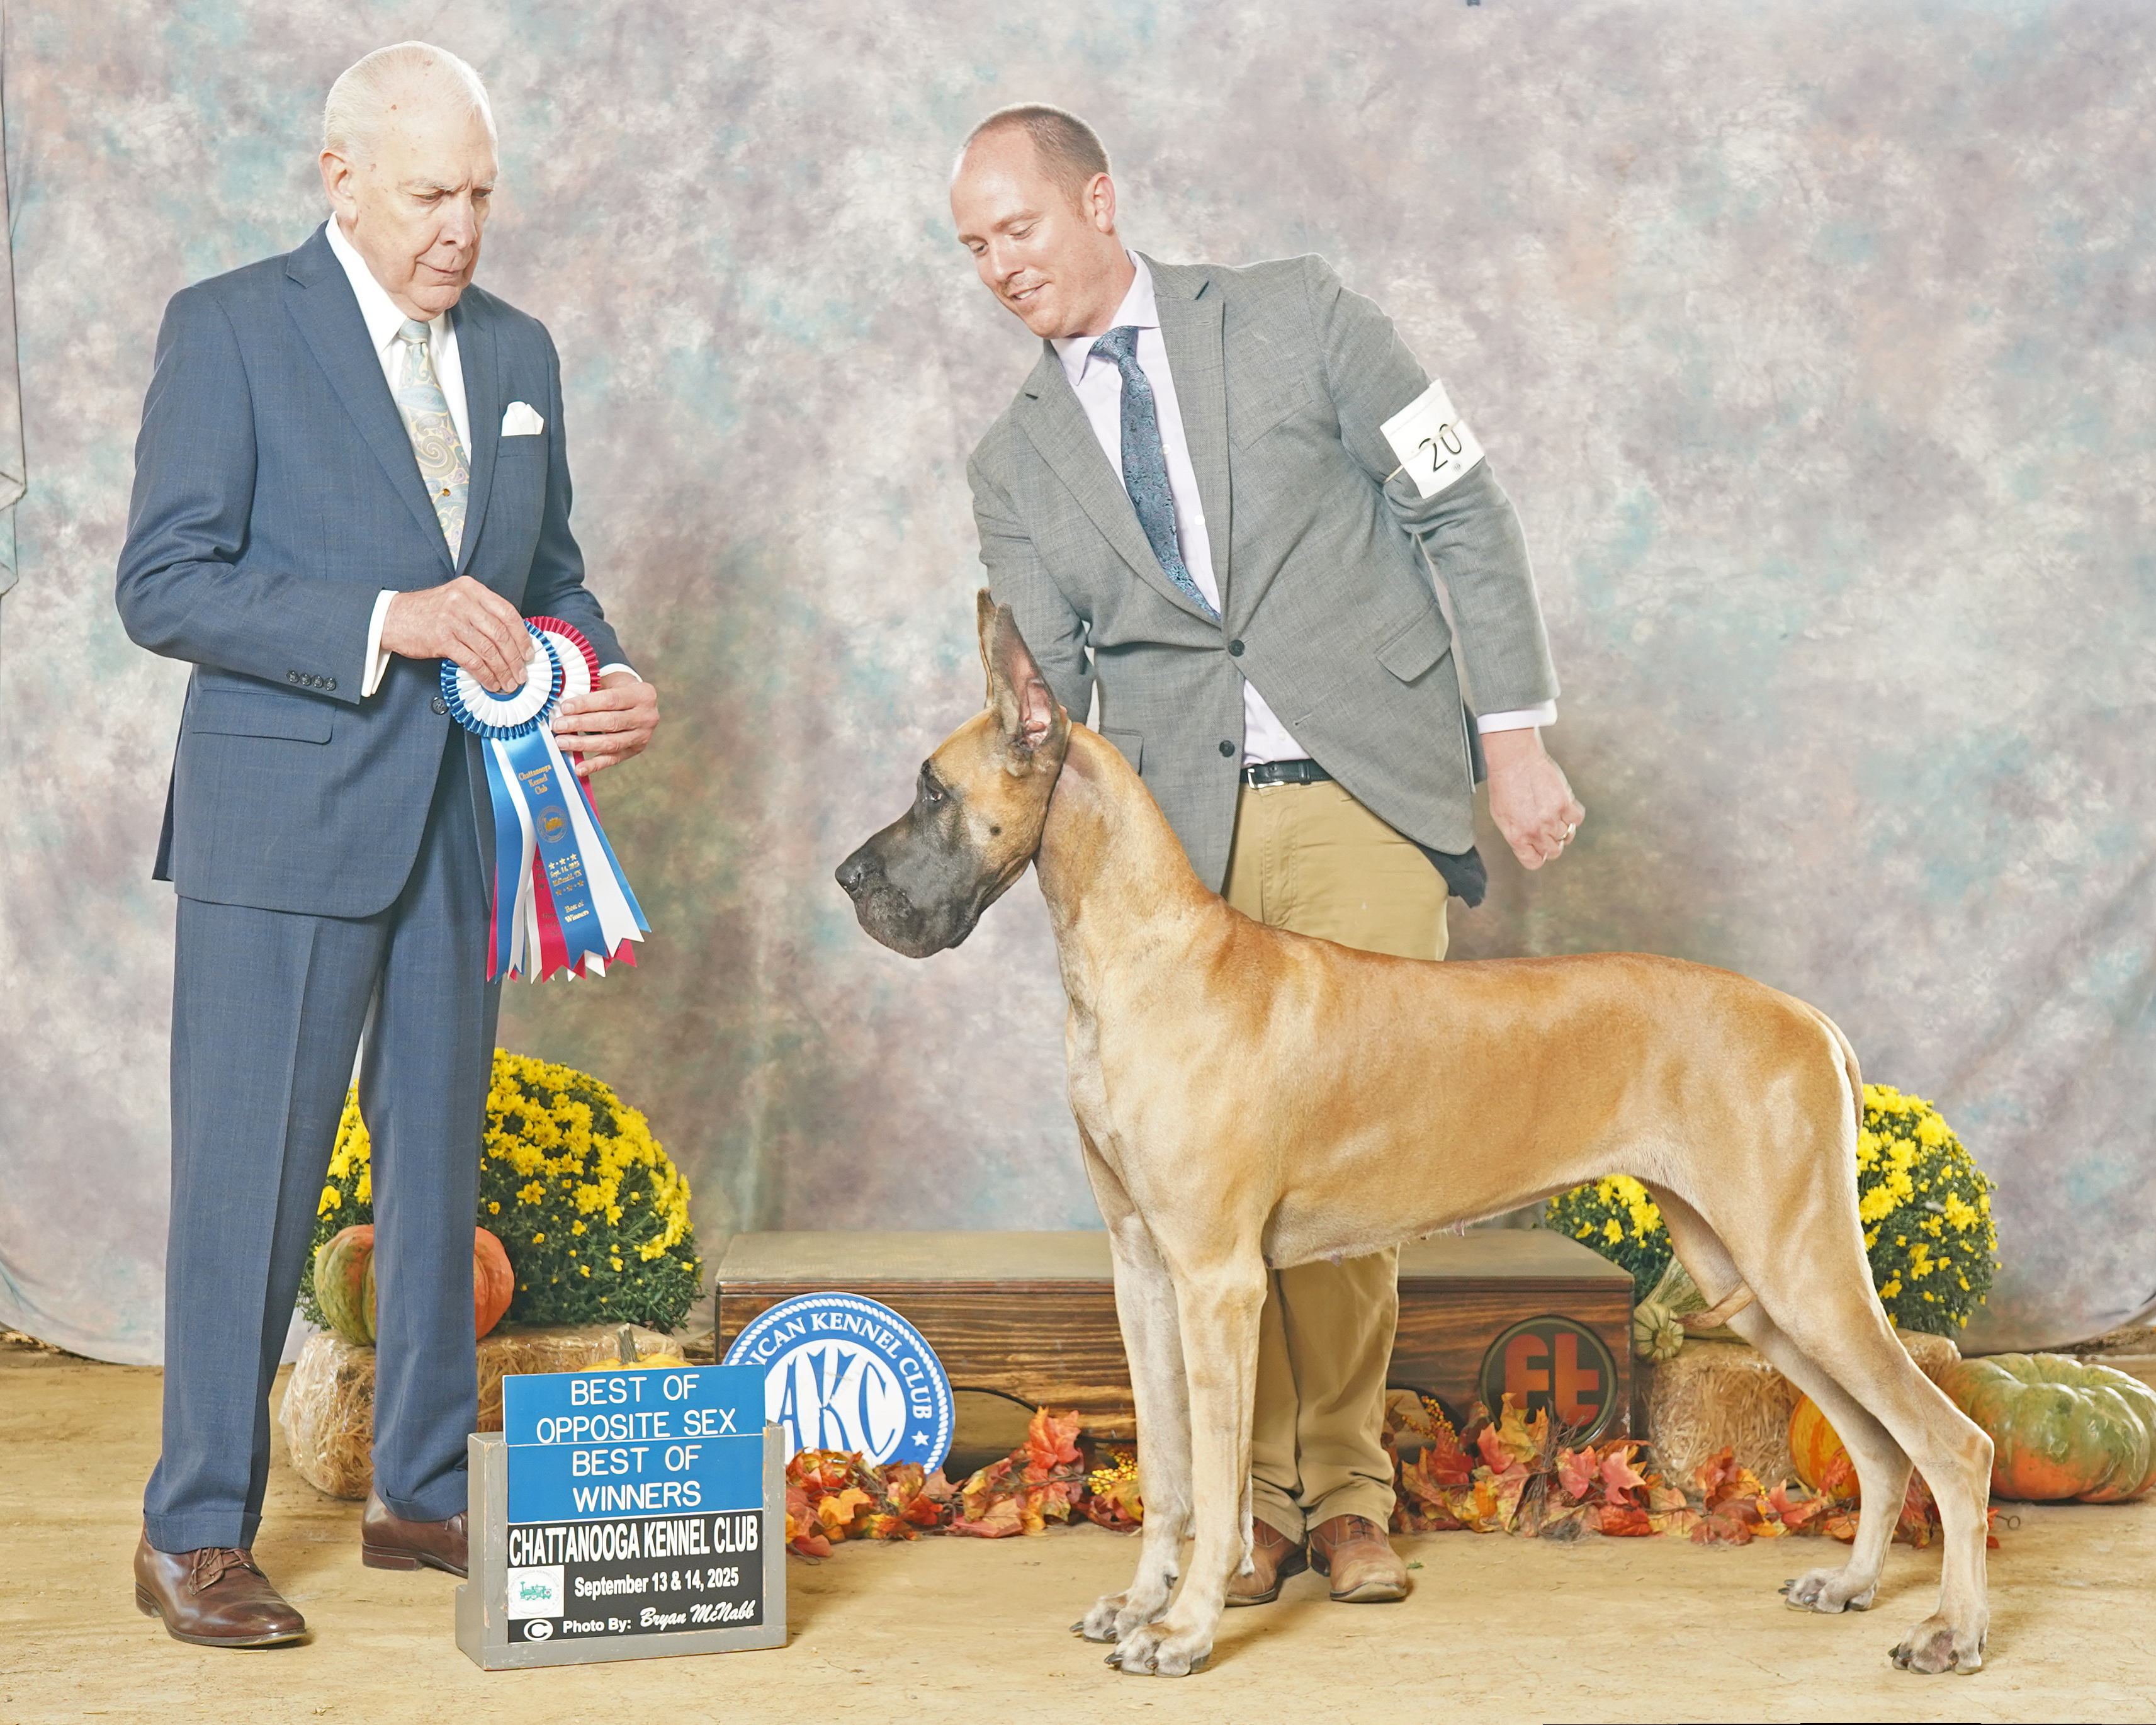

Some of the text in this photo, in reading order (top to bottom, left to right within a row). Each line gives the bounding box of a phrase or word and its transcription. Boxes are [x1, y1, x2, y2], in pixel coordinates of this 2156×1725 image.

[1418, 423, 1462, 473] 20
[518, 764, 552, 781] Chattanooga
[528, 773, 548, 787] Kennel
[534, 784, 548, 795] Club
[565, 910, 589, 923] Winners
[750, 1312, 932, 1420] ICAN KENNEL CLUB
[572, 1374, 700, 1406] BEST OF
[776, 1345, 895, 1457] AKC
[537, 1408, 737, 1444] OPPOSITE SEX
[572, 1444, 703, 1477] BEST OF
[572, 1480, 701, 1513] WINNERS
[509, 1515, 758, 1566] CHATTANOOGA KENNEL CLUB
[574, 1575, 649, 1601] September
[652, 1571, 668, 1592] 13
[670, 1570, 682, 1591] &
[684, 1569, 704, 1592] 14,
[707, 1567, 739, 1588] 2025
[563, 1619, 605, 1634] Photo
[608, 1617, 631, 1632] By:
[640, 1607, 687, 1631] Bryan
[689, 1599, 756, 1623] McNabb
